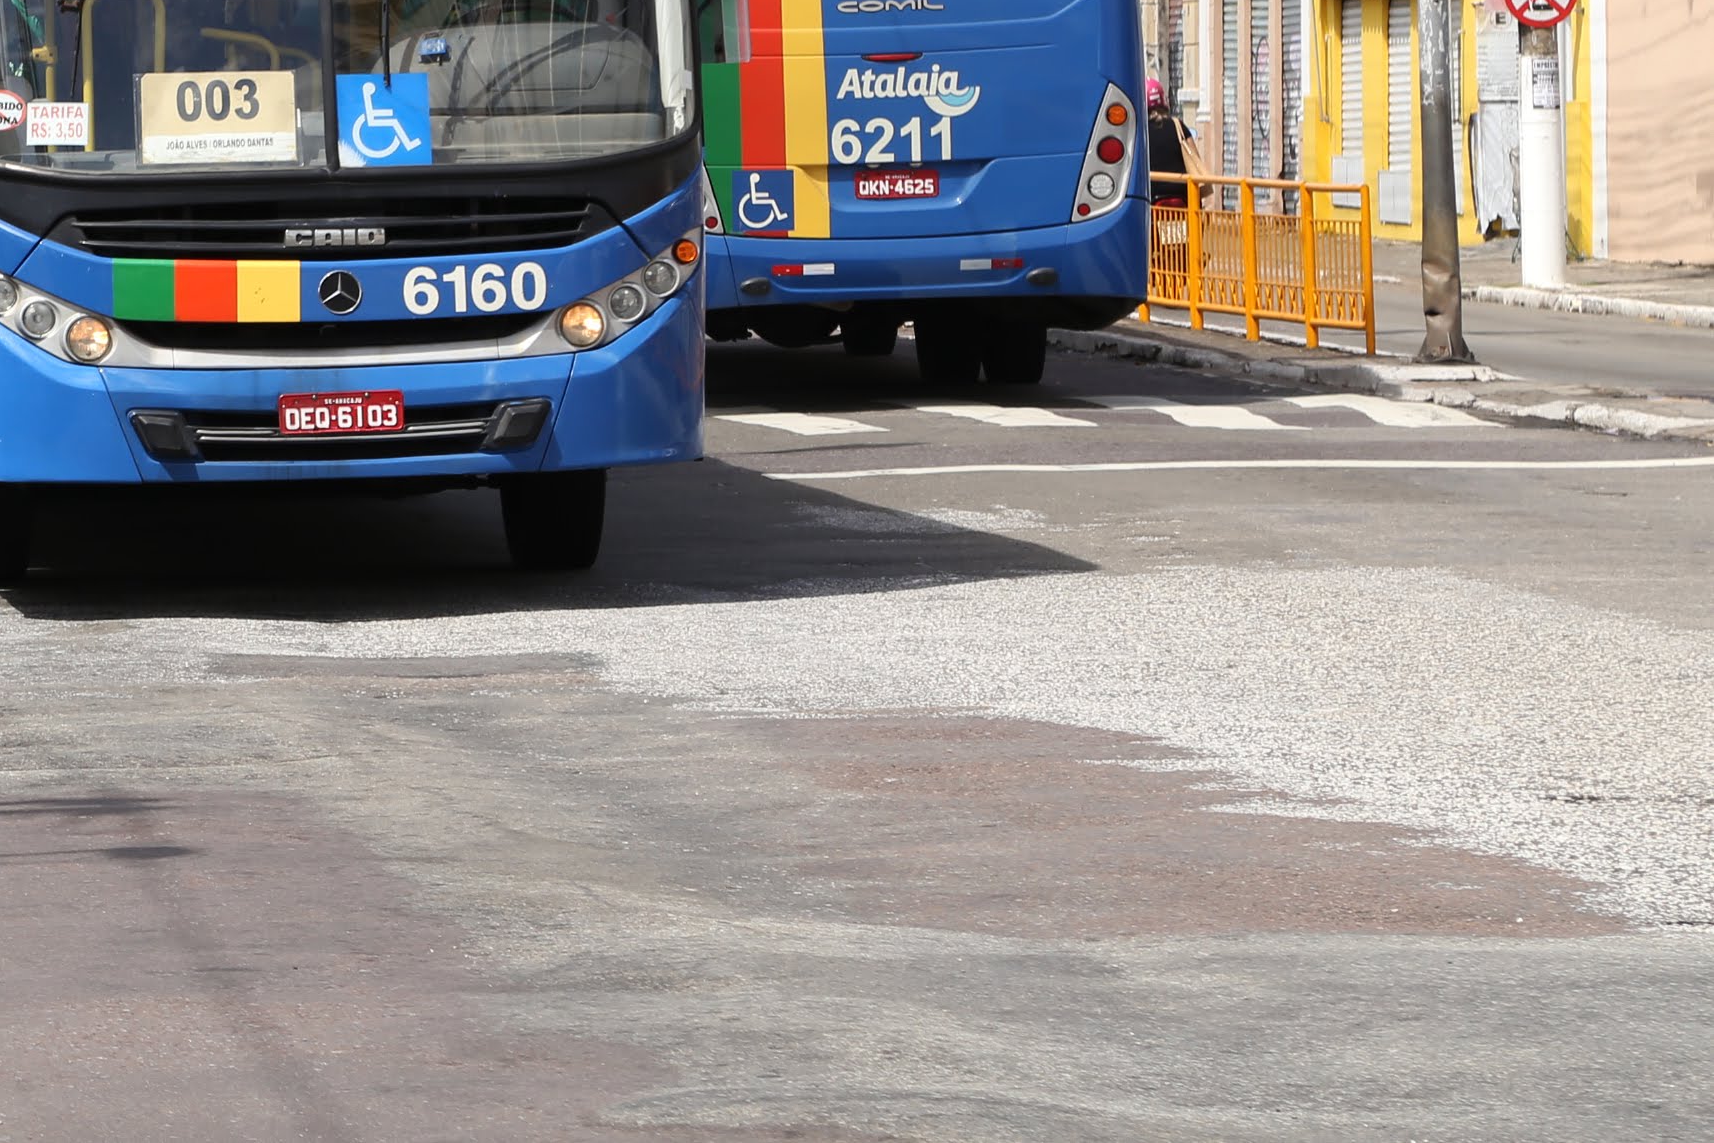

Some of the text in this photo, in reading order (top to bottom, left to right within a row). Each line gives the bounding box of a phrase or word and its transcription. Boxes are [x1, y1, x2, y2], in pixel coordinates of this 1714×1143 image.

[836, 63, 970, 100] Atalaia
[31, 106, 84, 119] TARIFA
[176, 78, 260, 123] 003
[186, 139, 208, 150] ALVES
[212, 138, 246, 149] ORLANDO
[831, 116, 952, 165] 6211
[285, 228, 386, 247] CAIO
[402, 261, 547, 316] 6160
